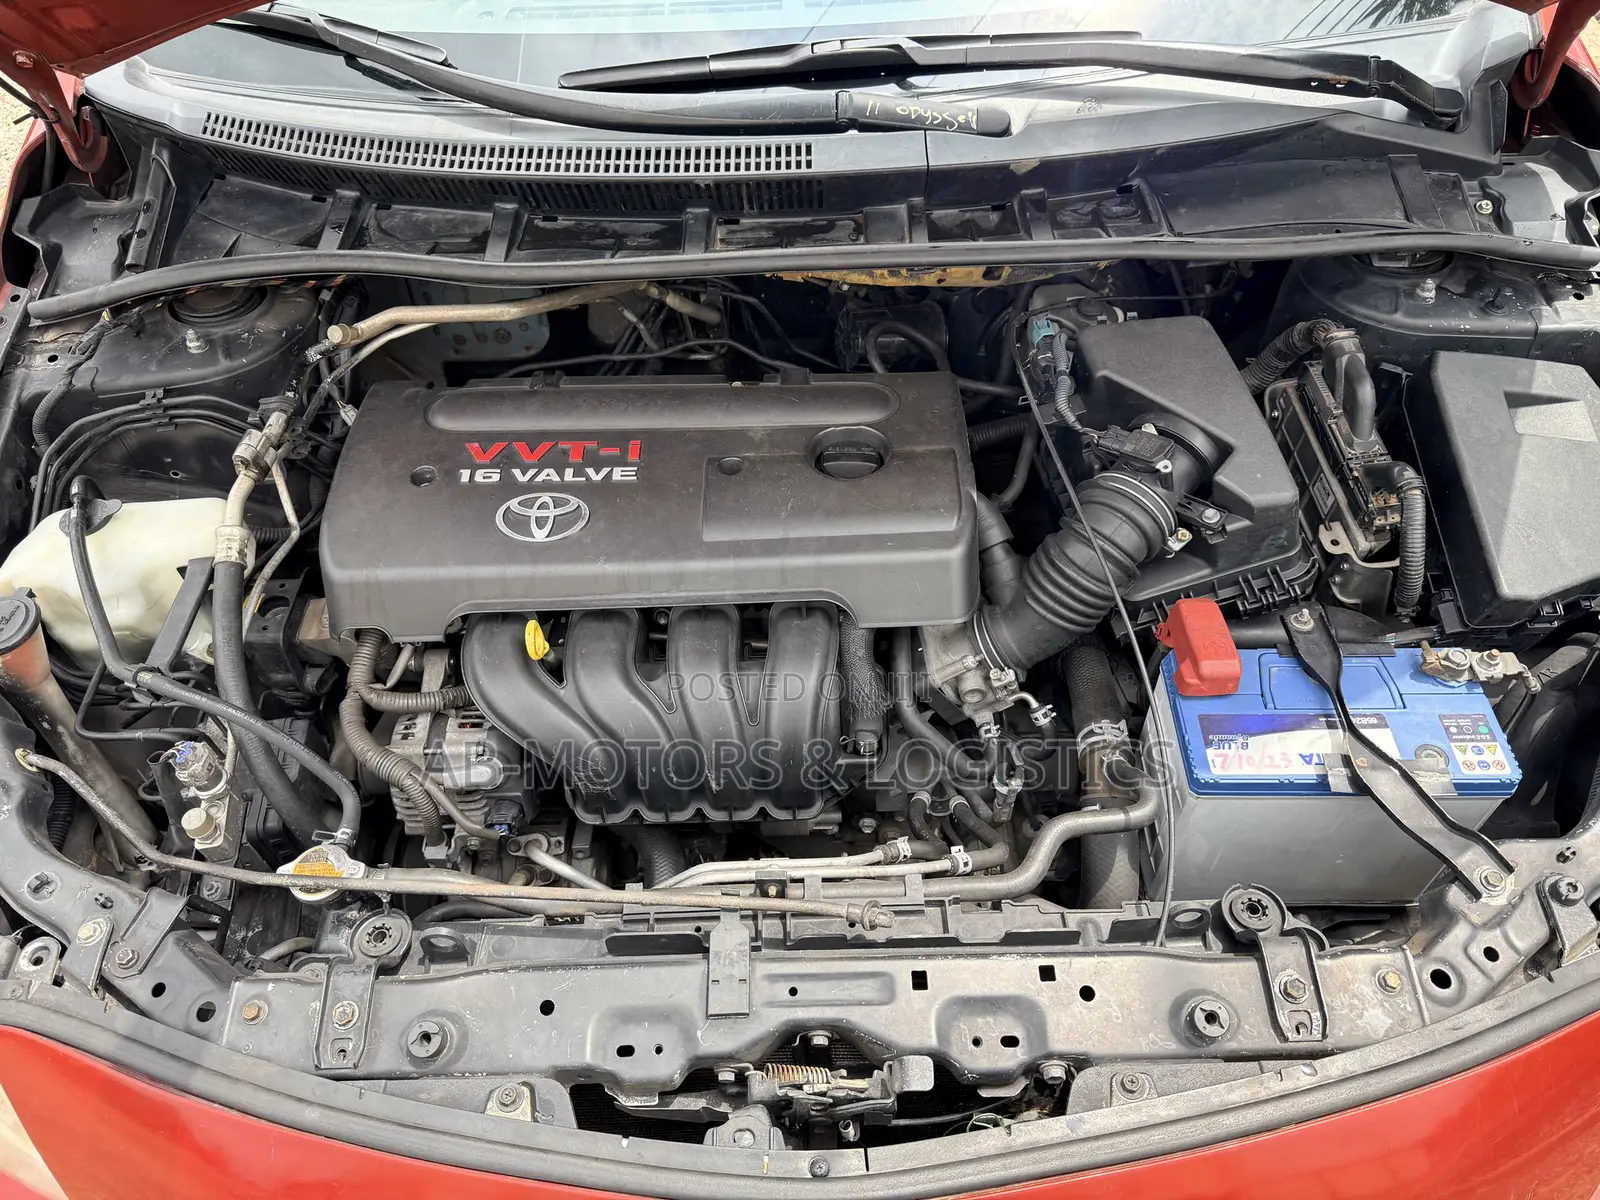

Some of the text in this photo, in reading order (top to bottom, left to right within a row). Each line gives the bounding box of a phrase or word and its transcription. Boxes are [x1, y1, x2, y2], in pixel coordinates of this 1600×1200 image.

[459, 466, 639, 483] 16 VALVE
[1213, 741, 1249, 750] BLUE
